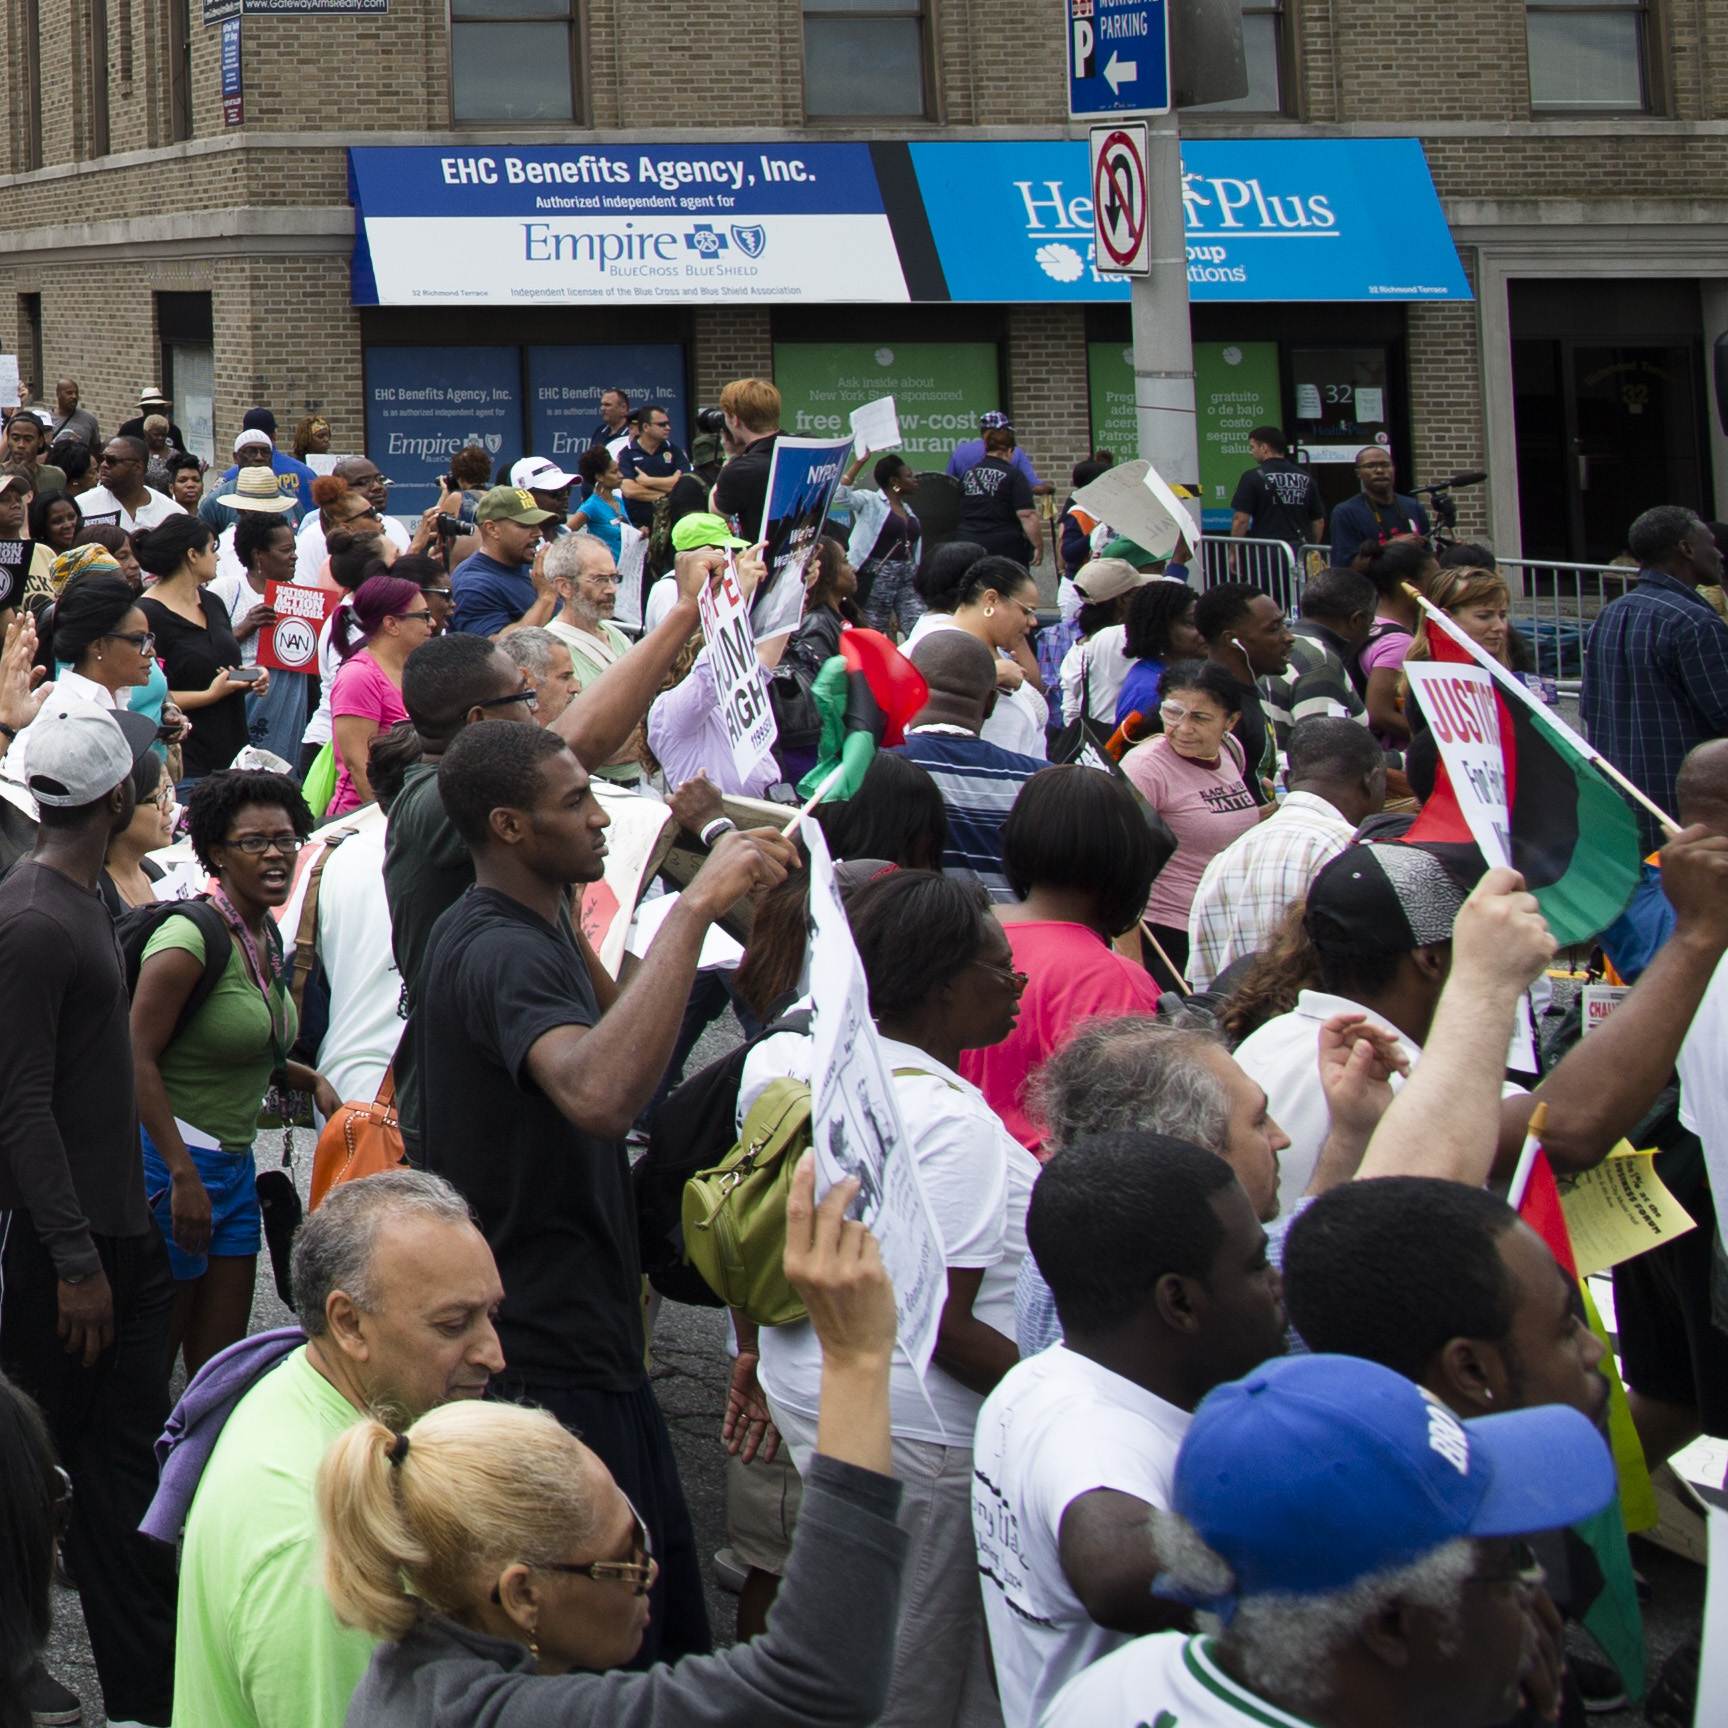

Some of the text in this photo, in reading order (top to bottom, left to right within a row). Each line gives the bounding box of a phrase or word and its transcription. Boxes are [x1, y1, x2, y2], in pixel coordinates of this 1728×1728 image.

[1100, 12, 1148, 40] PARKING
[1074, 20, 1094, 78] P
[441, 156, 816, 191] EHC Benefits Agency, Inc.
[535, 195, 735, 210] Authorized independent agent for
[1207, 177, 1336, 228] Plus
[520, 222, 678, 271] Empire
[838, 377, 934, 388] Ask inside about
[375, 388, 444, 400] EHC Benefits
[1211, 392, 1258, 404] gratuito
[1325, 385, 1352, 403] 32
[1237, 404, 1263, 417] bajo
[796, 410, 841, 430] free
[1220, 418, 1252, 428] costo
[280, 633, 309, 651] NAN
